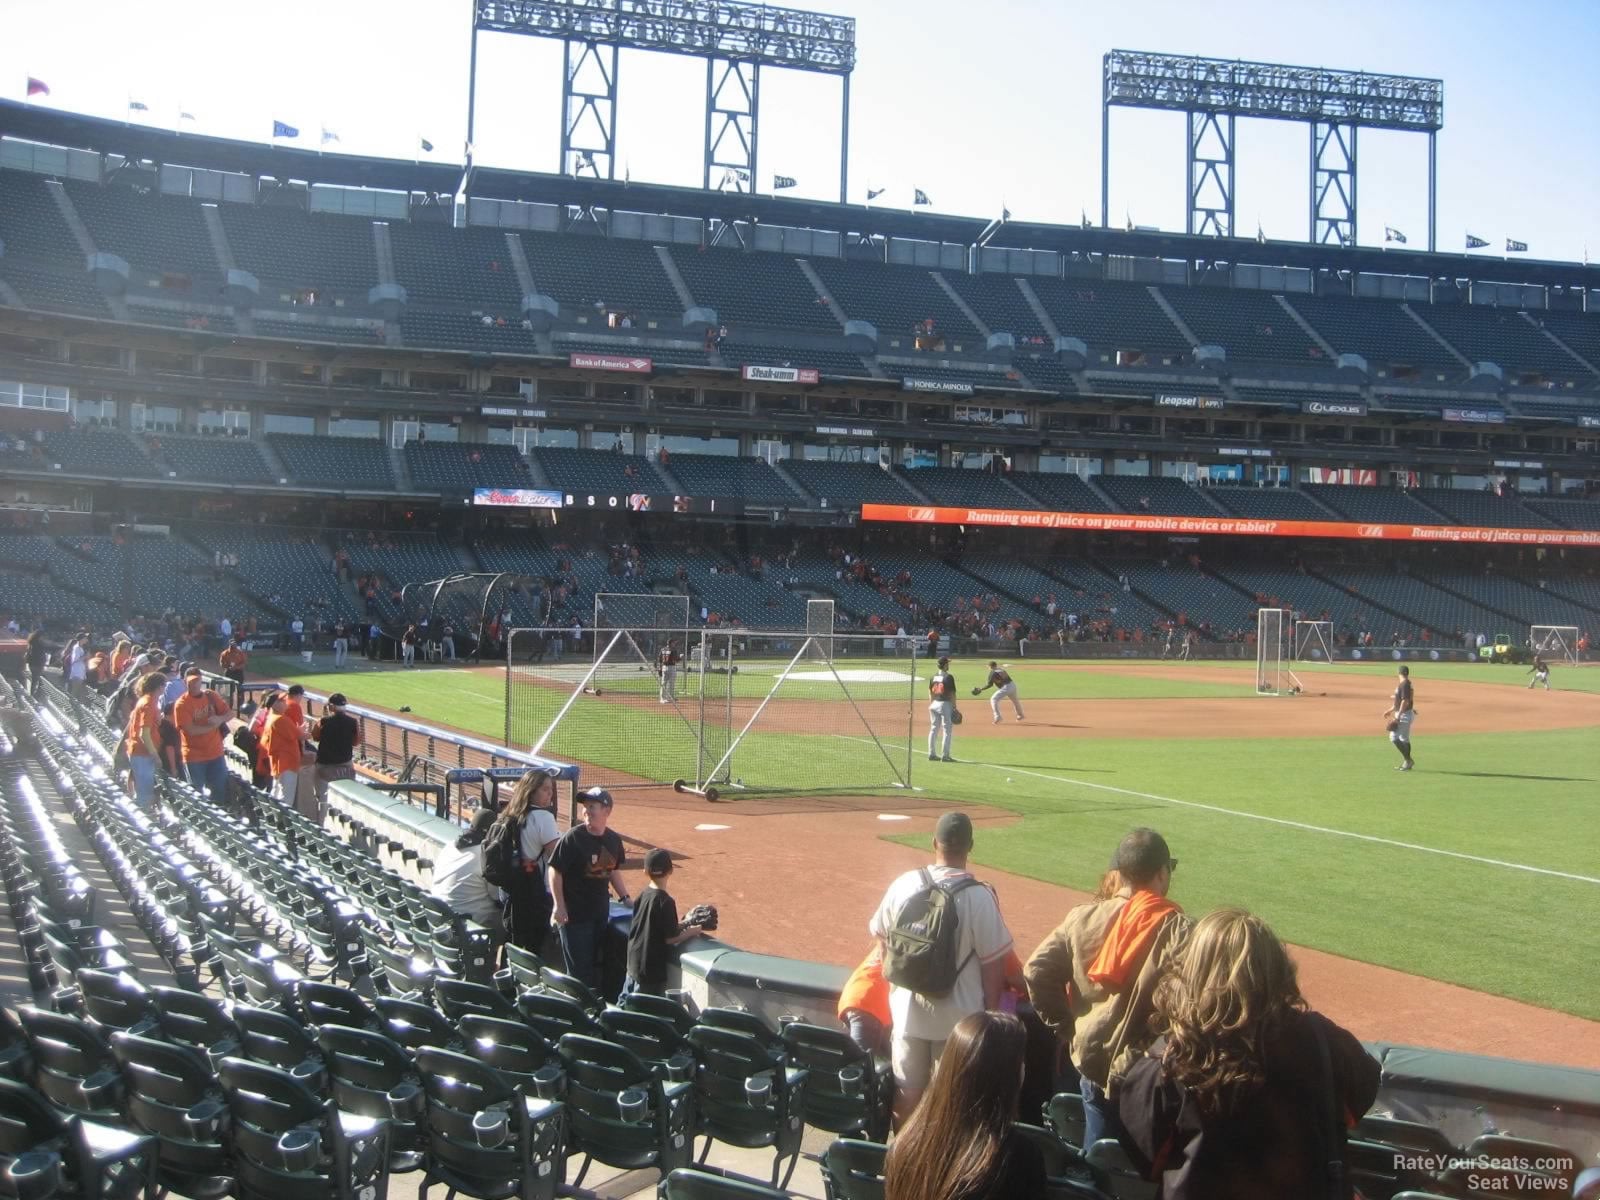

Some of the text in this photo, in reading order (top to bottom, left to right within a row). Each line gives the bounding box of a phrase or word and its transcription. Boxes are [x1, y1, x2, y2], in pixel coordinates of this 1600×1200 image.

[575, 358, 593, 366] Bank
[600, 360, 630, 369] America
[942, 383, 973, 391] MINOLTA
[1323, 405, 1360, 413] LEXUS
[518, 494, 549, 505] LIGHT
[565, 494, 575, 506] B
[587, 495, 596, 506] S
[967, 511, 1277, 533] Running out of juice on your mobile device or tablet?
[1411, 527, 1460, 541] Running
[1460, 530, 1481, 540] out
[1481, 530, 1494, 542] of
[1492, 530, 1521, 543] juice
[1521, 533, 1537, 541] on
[1537, 534, 1565, 545] your
